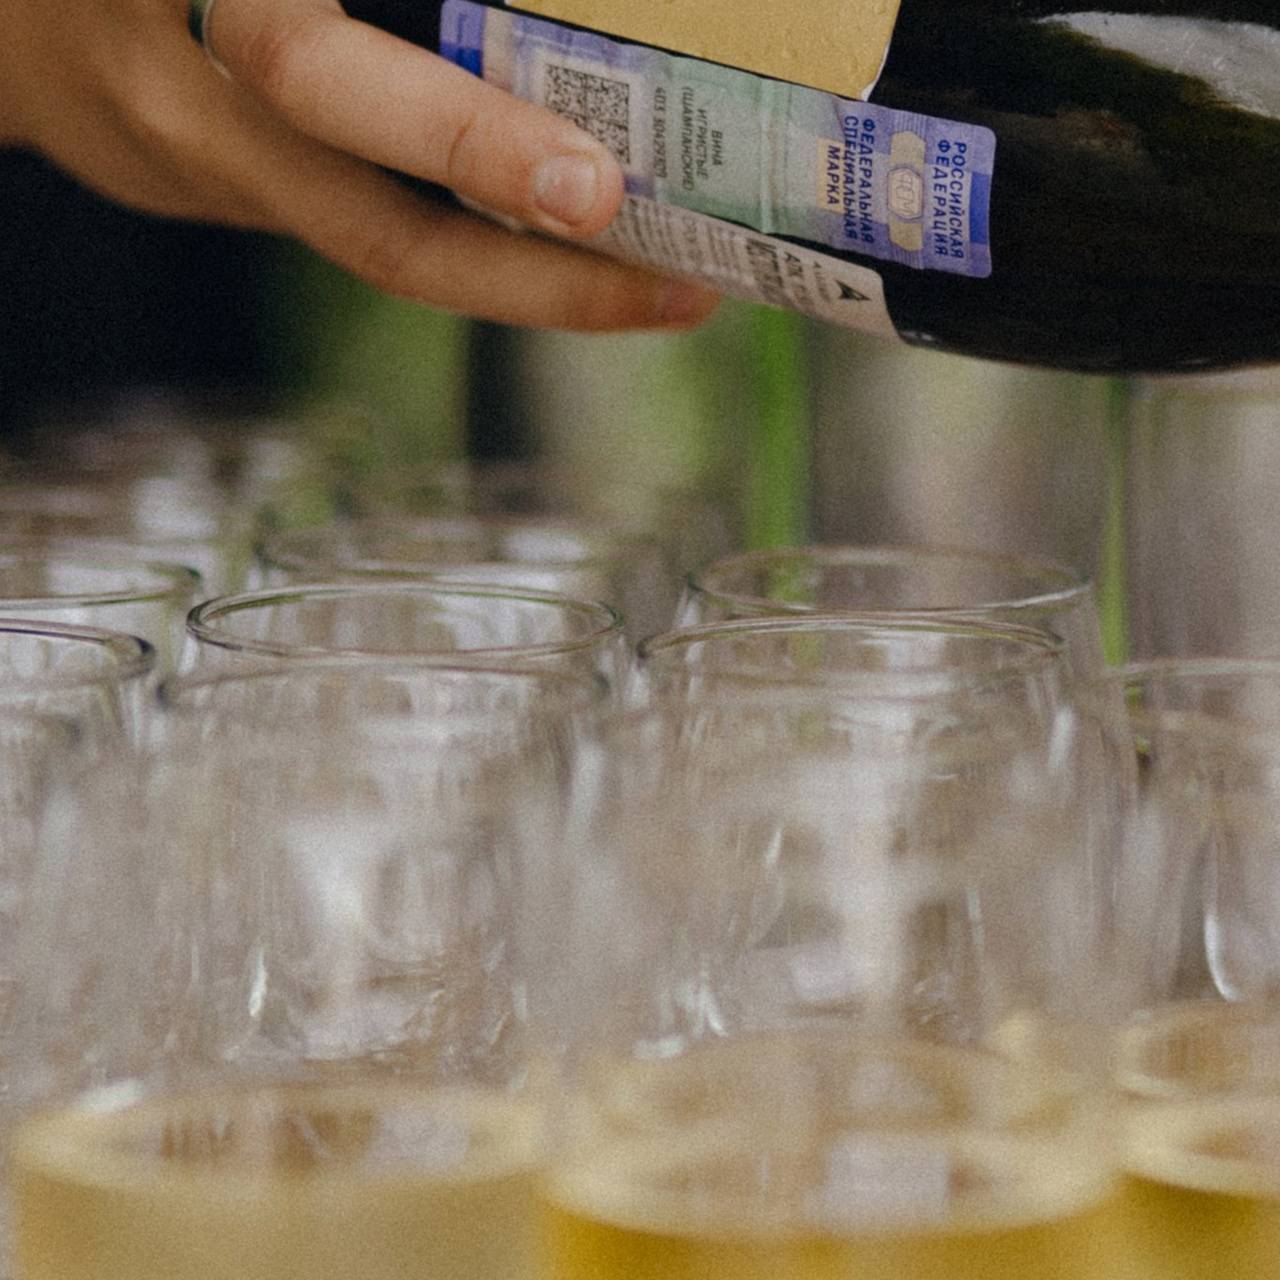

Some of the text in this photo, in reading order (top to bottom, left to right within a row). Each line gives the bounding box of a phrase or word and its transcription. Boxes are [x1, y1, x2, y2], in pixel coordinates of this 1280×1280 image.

[696, 108, 708, 180] ИГРИСТЫЕ
[711, 130, 723, 166] ВИНА
[826, 145, 841, 205] МАРКА
[843, 115, 859, 241] СПЕЦИАЛЬНАЯ
[858, 118, 876, 244] ФЕДЕРАЛЬНАЯ
[931, 139, 951, 257] ФЕДЕРАЦИЯ
[949, 141, 967, 259] РОССИЙСКАЯ
